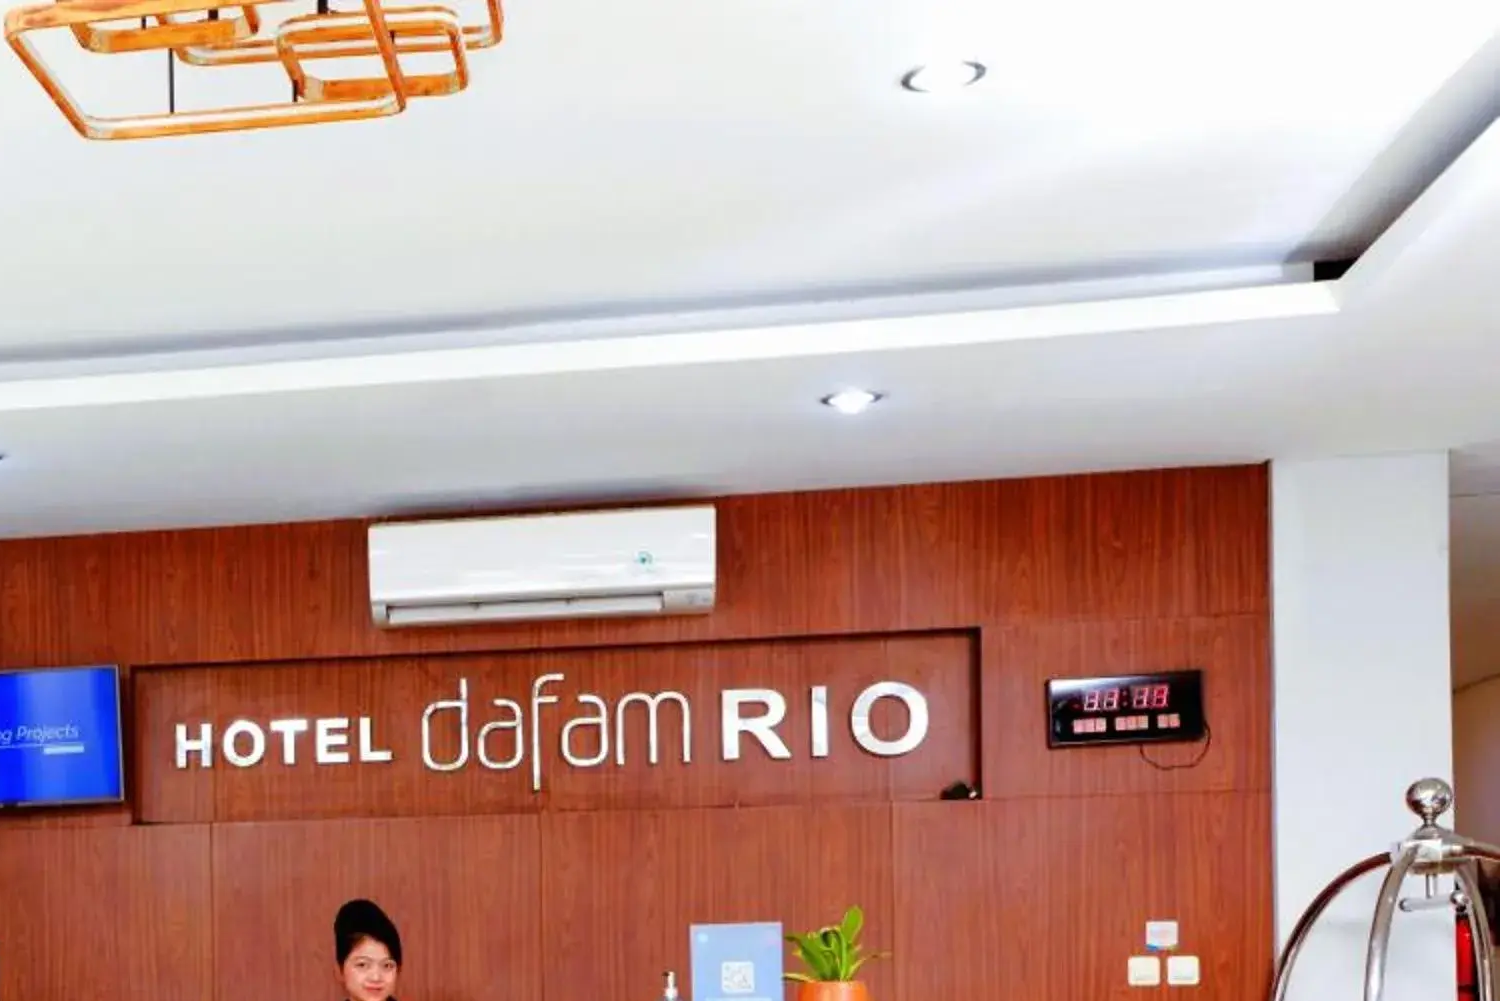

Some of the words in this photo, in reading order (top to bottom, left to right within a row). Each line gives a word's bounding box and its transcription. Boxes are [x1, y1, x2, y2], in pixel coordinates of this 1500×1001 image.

[16, 723, 79, 742] Projects
[176, 717, 393, 769] HOTEL
[422, 673, 691, 792] dafam
[721, 681, 929, 761] RIO
